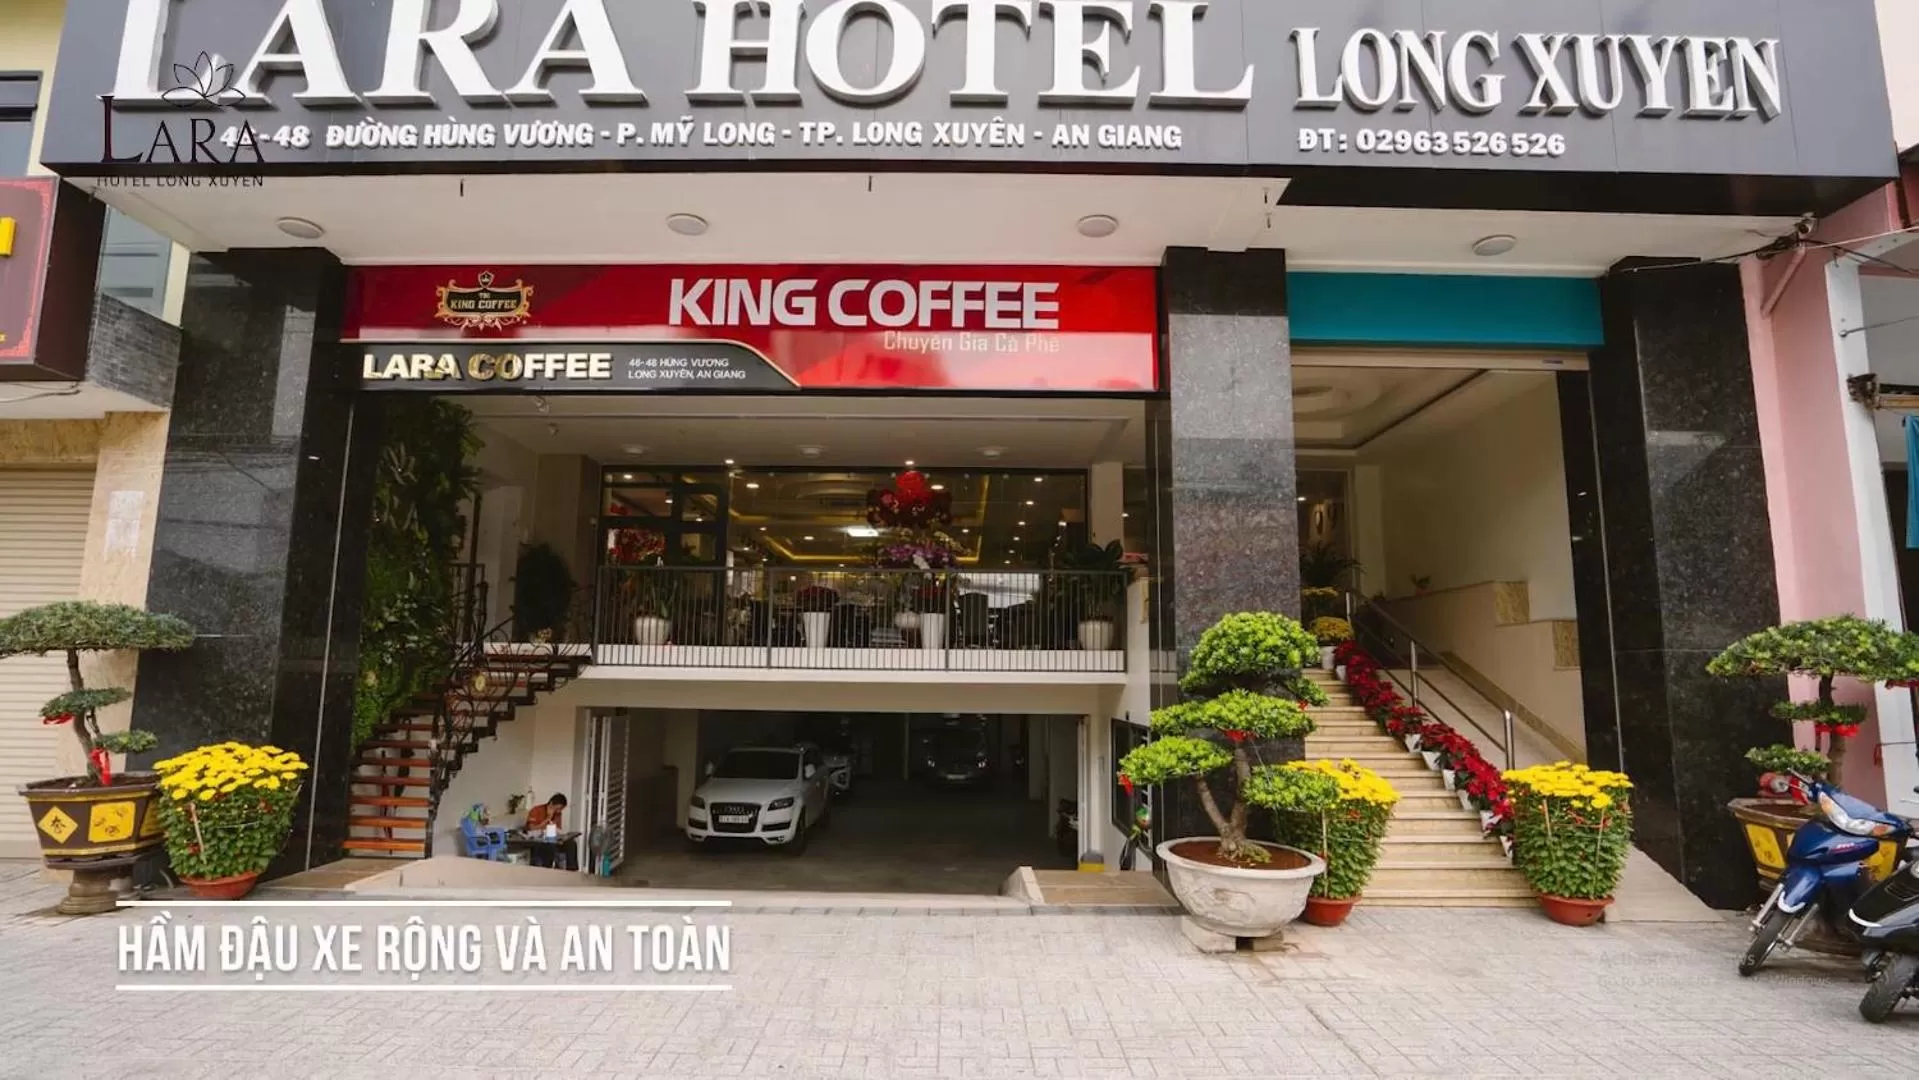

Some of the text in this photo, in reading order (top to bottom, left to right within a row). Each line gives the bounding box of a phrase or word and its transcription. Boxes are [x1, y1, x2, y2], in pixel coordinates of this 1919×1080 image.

[97, 0, 1255, 104] LARA HOTEL
[1293, 28, 1780, 118] LONG XUYEN
[326, 116, 418, 147] ĐƯỜNG
[423, 116, 496, 146] HÙNG
[503, 120, 593, 146] VƯƠNG
[616, 122, 644, 145] P.
[651, 115, 694, 146] MỸ
[703, 122, 775, 146] LONG
[799, 122, 844, 146] TP.
[853, 122, 922, 146] LONG
[932, 116, 1025, 147] XUYÊN
[1052, 124, 1090, 146] AN
[1098, 124, 1183, 149] GIANG
[1299, 128, 1567, 156] ĐT: 02963 526 526
[450, 300, 517, 309] KING COFFEE
[669, 278, 1060, 330] KING COFFEE
[959, 332, 988, 351] Gia
[363, 353, 612, 381] LARA COFFEE
[628, 371, 656, 379] LONG
[696, 370, 711, 378] AN
[713, 370, 746, 379] GIANG
